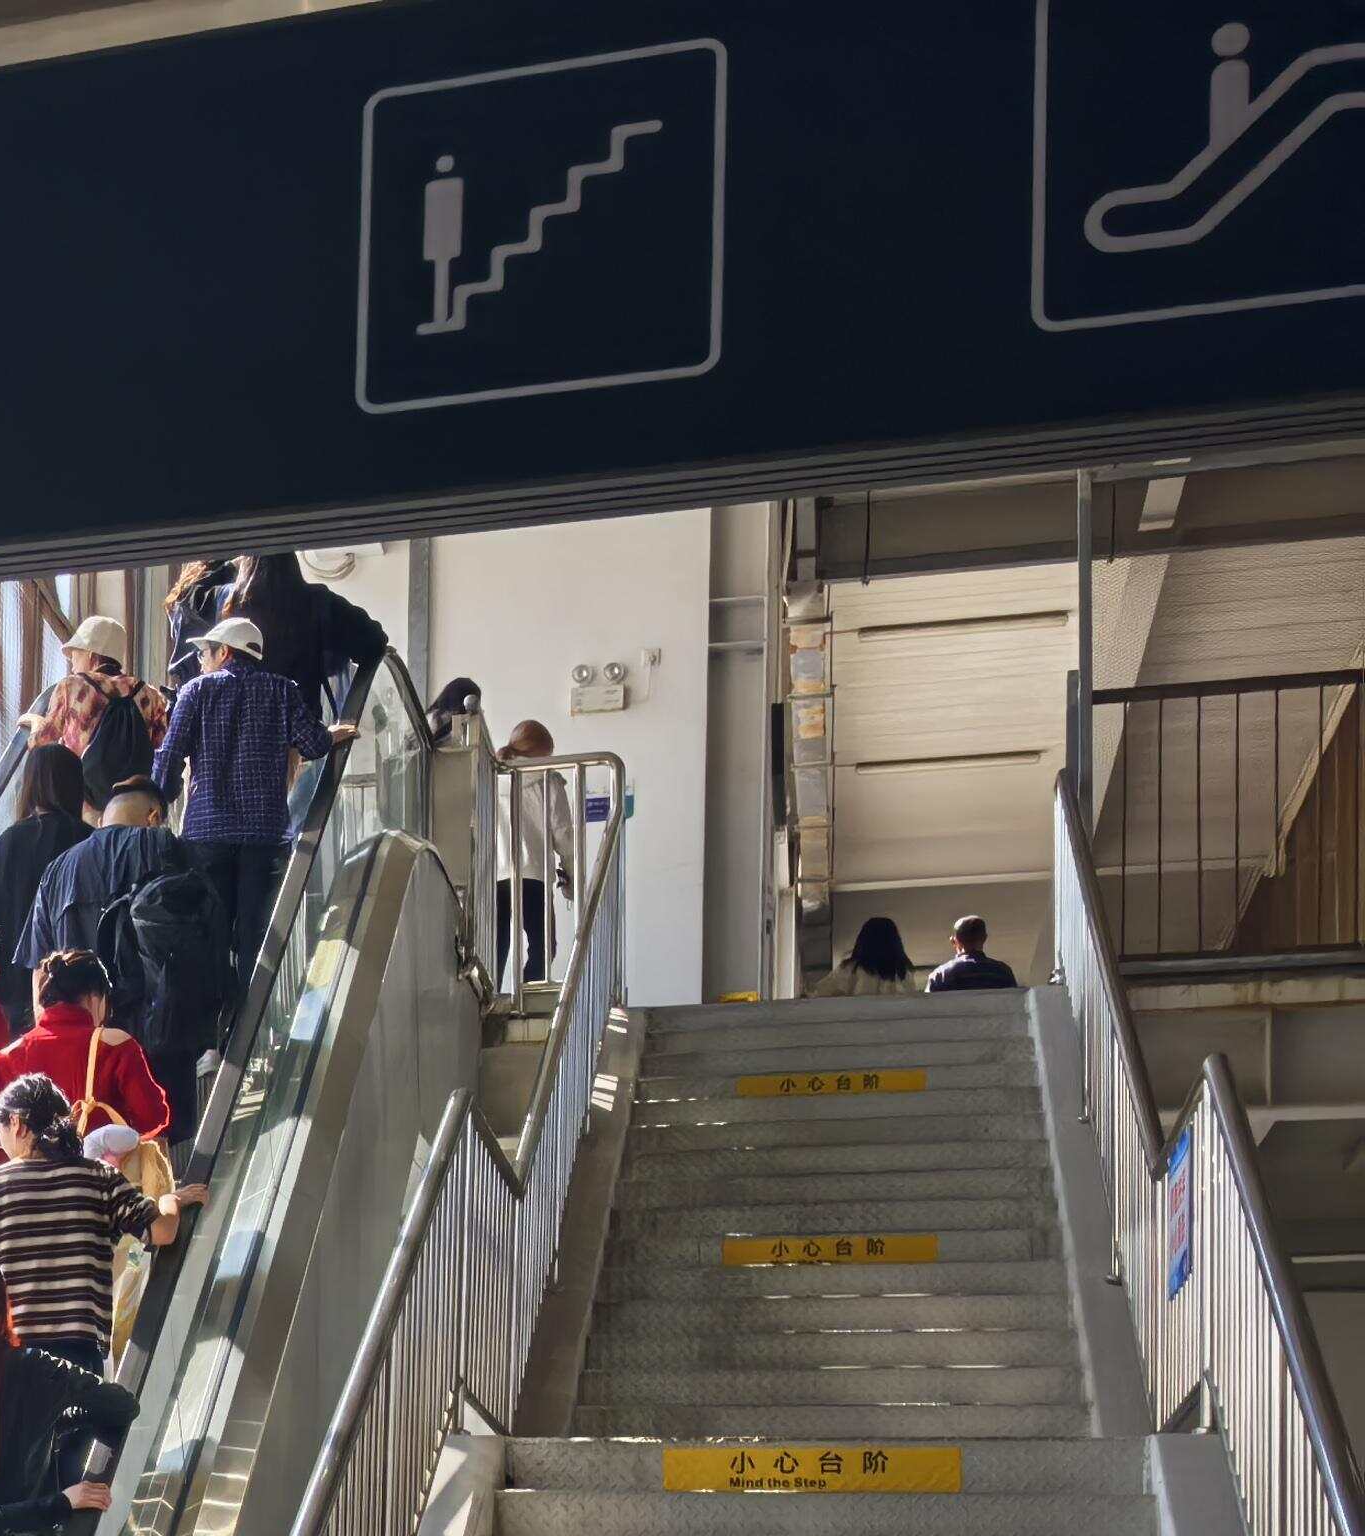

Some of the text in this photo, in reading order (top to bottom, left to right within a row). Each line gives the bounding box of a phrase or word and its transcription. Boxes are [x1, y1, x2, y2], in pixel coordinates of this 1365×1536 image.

[779, 1074, 879, 1093] 小心台阶
[771, 1238, 885, 1257] 小心台阶
[730, 1450, 889, 1475] 小心台阶
[729, 1477, 826, 1489] Mind the Step
